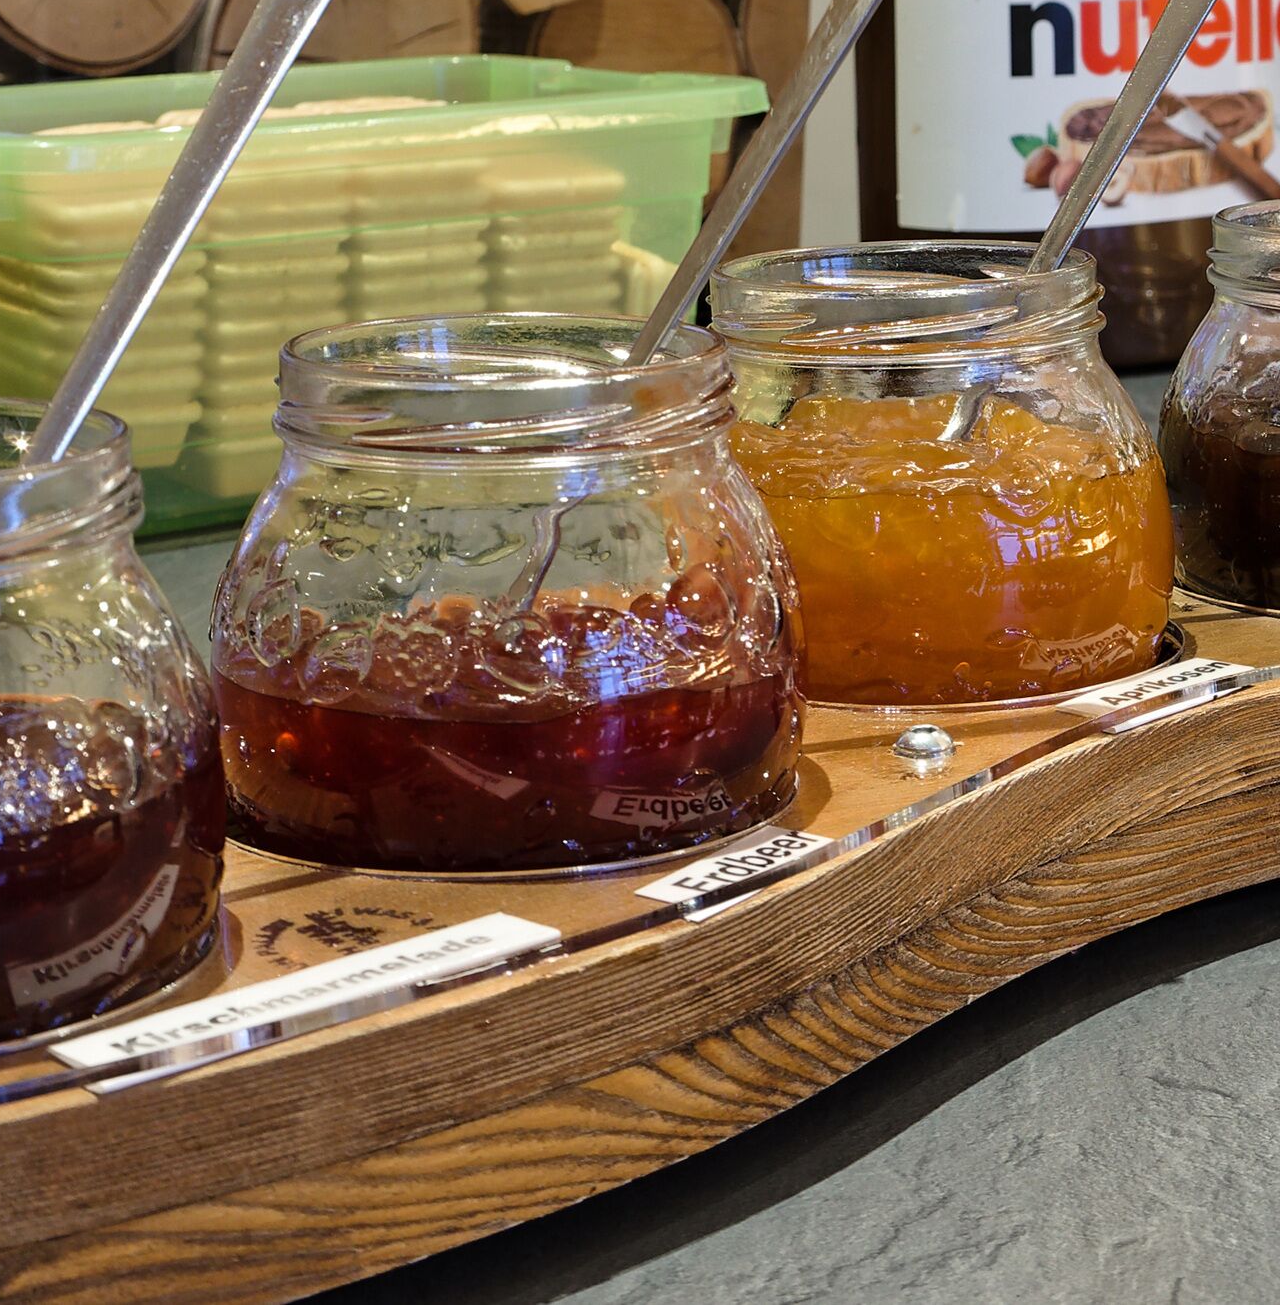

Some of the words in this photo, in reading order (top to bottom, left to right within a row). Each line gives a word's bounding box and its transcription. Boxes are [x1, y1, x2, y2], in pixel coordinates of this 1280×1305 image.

[1099, 660, 1232, 707] Aprikosen
[671, 829, 820, 893] Erdbeer
[108, 931, 493, 1057] Kirschmarmelade
